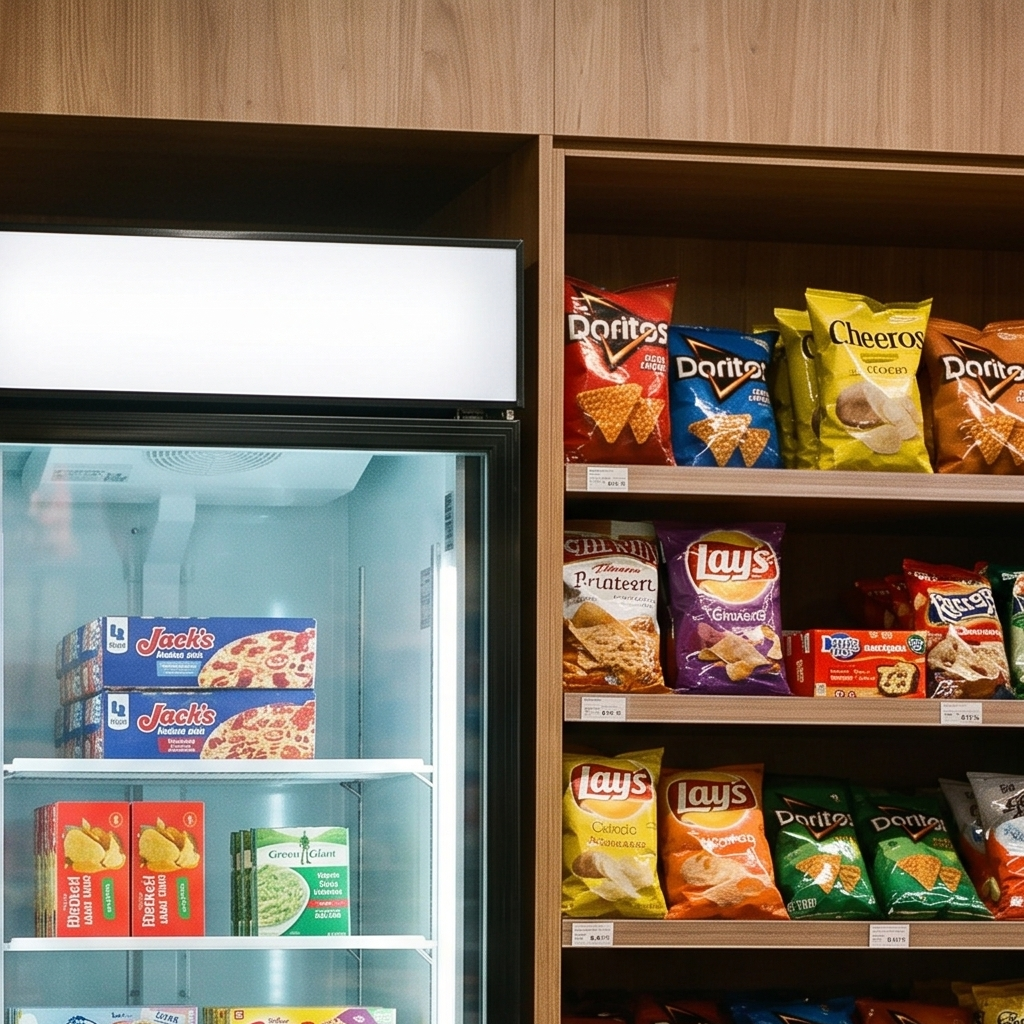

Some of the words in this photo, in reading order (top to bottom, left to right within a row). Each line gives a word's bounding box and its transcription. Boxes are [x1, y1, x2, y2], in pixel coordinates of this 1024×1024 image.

[567, 313, 668, 345] Doritos
[696, 543, 772, 582] Lay's
[136, 626, 215, 657] Jack's
[137, 702, 217, 734] Jack's
[578, 766, 648, 801] Lay's
[678, 780, 748, 814] Lay's
